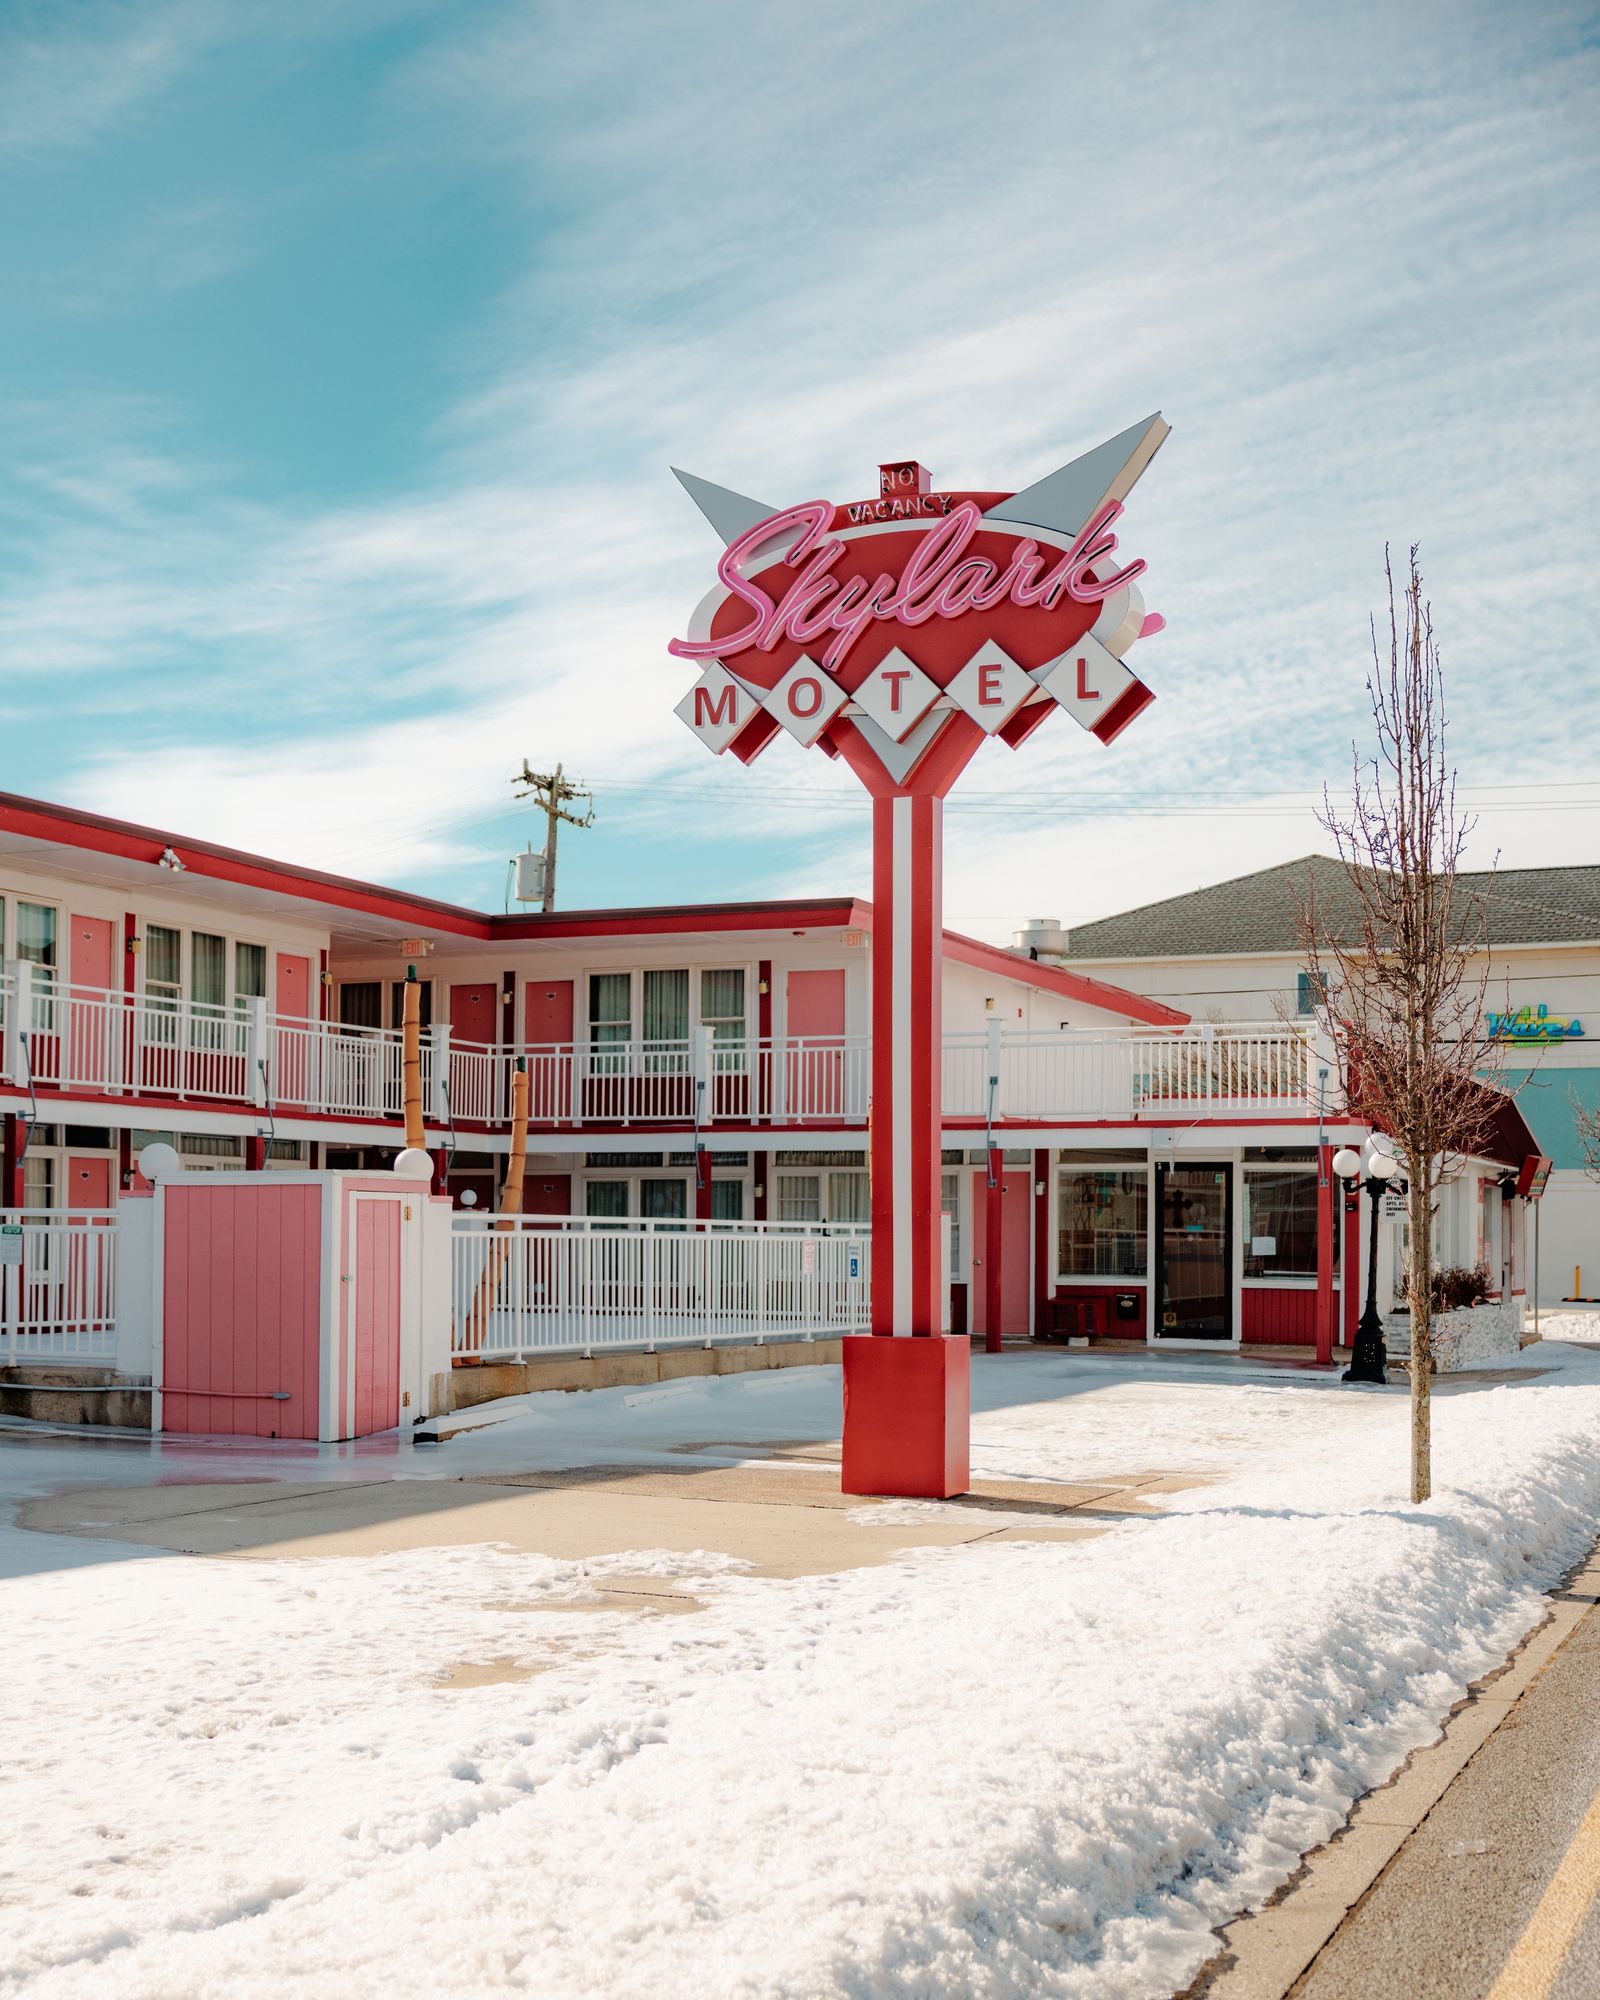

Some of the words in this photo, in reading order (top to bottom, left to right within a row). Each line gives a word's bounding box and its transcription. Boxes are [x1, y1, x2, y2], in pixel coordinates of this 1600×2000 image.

[880, 467, 914, 490] NO
[847, 494, 953, 523] VACANCY
[668, 500, 1148, 671] Skylark
[694, 657, 1101, 727] MOTEL
[1487, 1012, 1586, 1038] Waves
